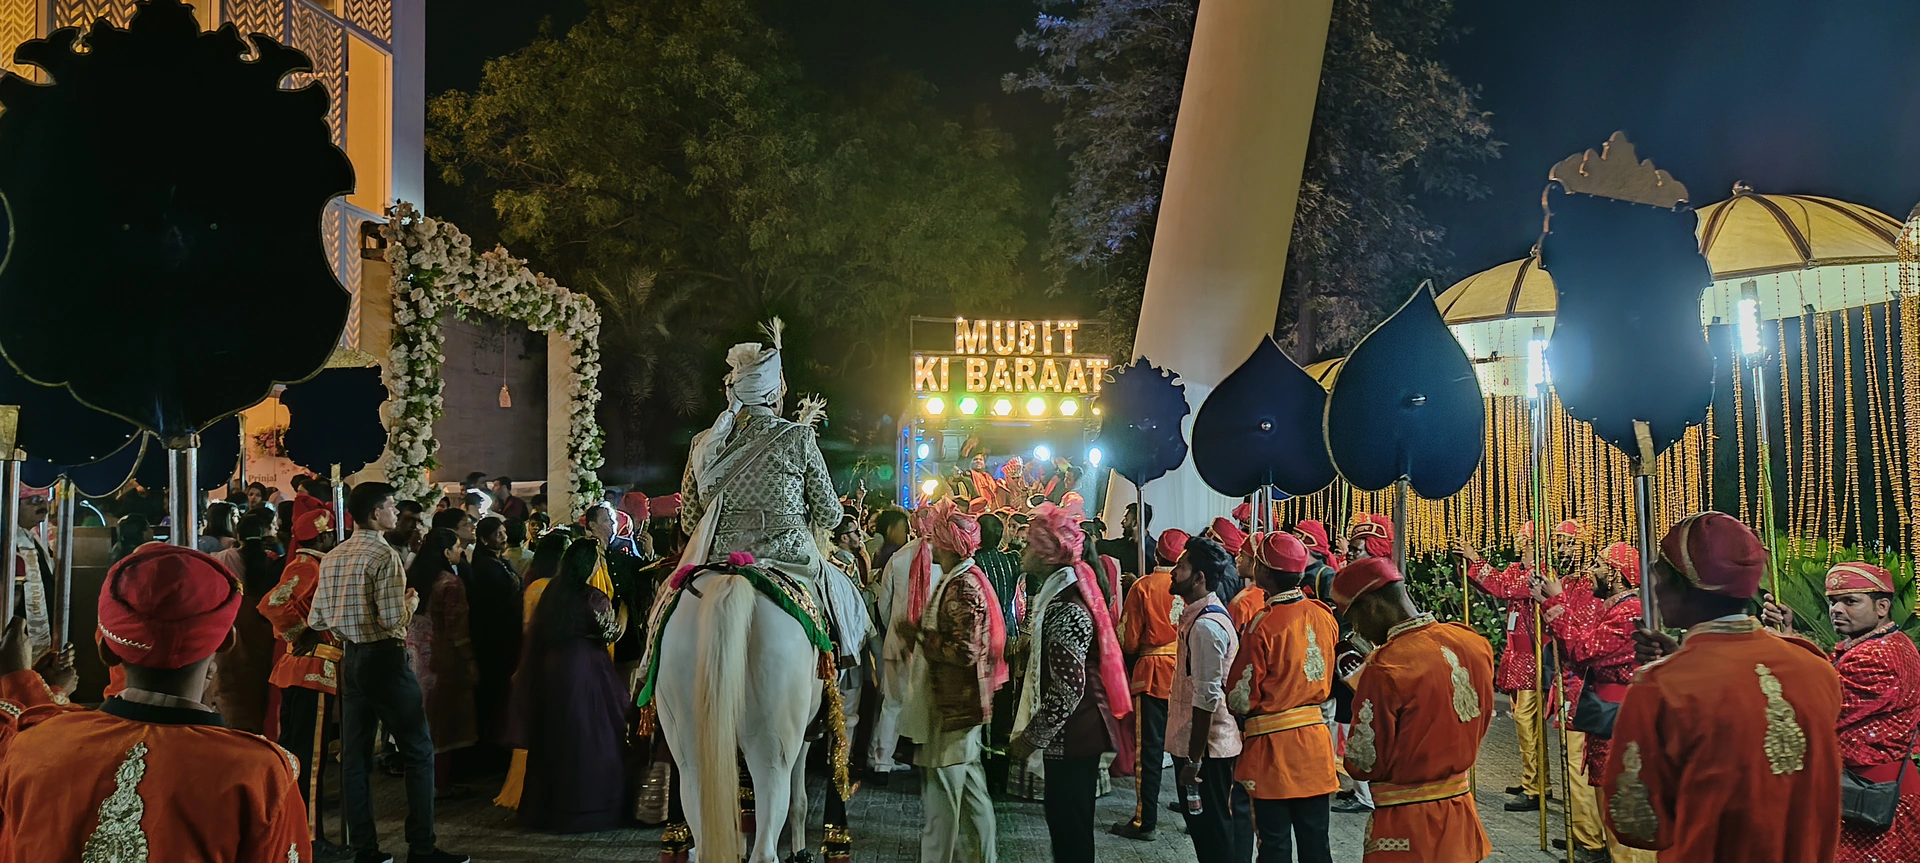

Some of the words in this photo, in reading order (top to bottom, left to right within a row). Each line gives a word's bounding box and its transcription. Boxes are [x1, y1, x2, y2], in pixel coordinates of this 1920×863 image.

[955, 318, 1078, 355] MUDIT
[914, 355, 950, 392] KI
[966, 357, 1109, 393] BARAAT
[31, 585, 42, 616] BARAAT
